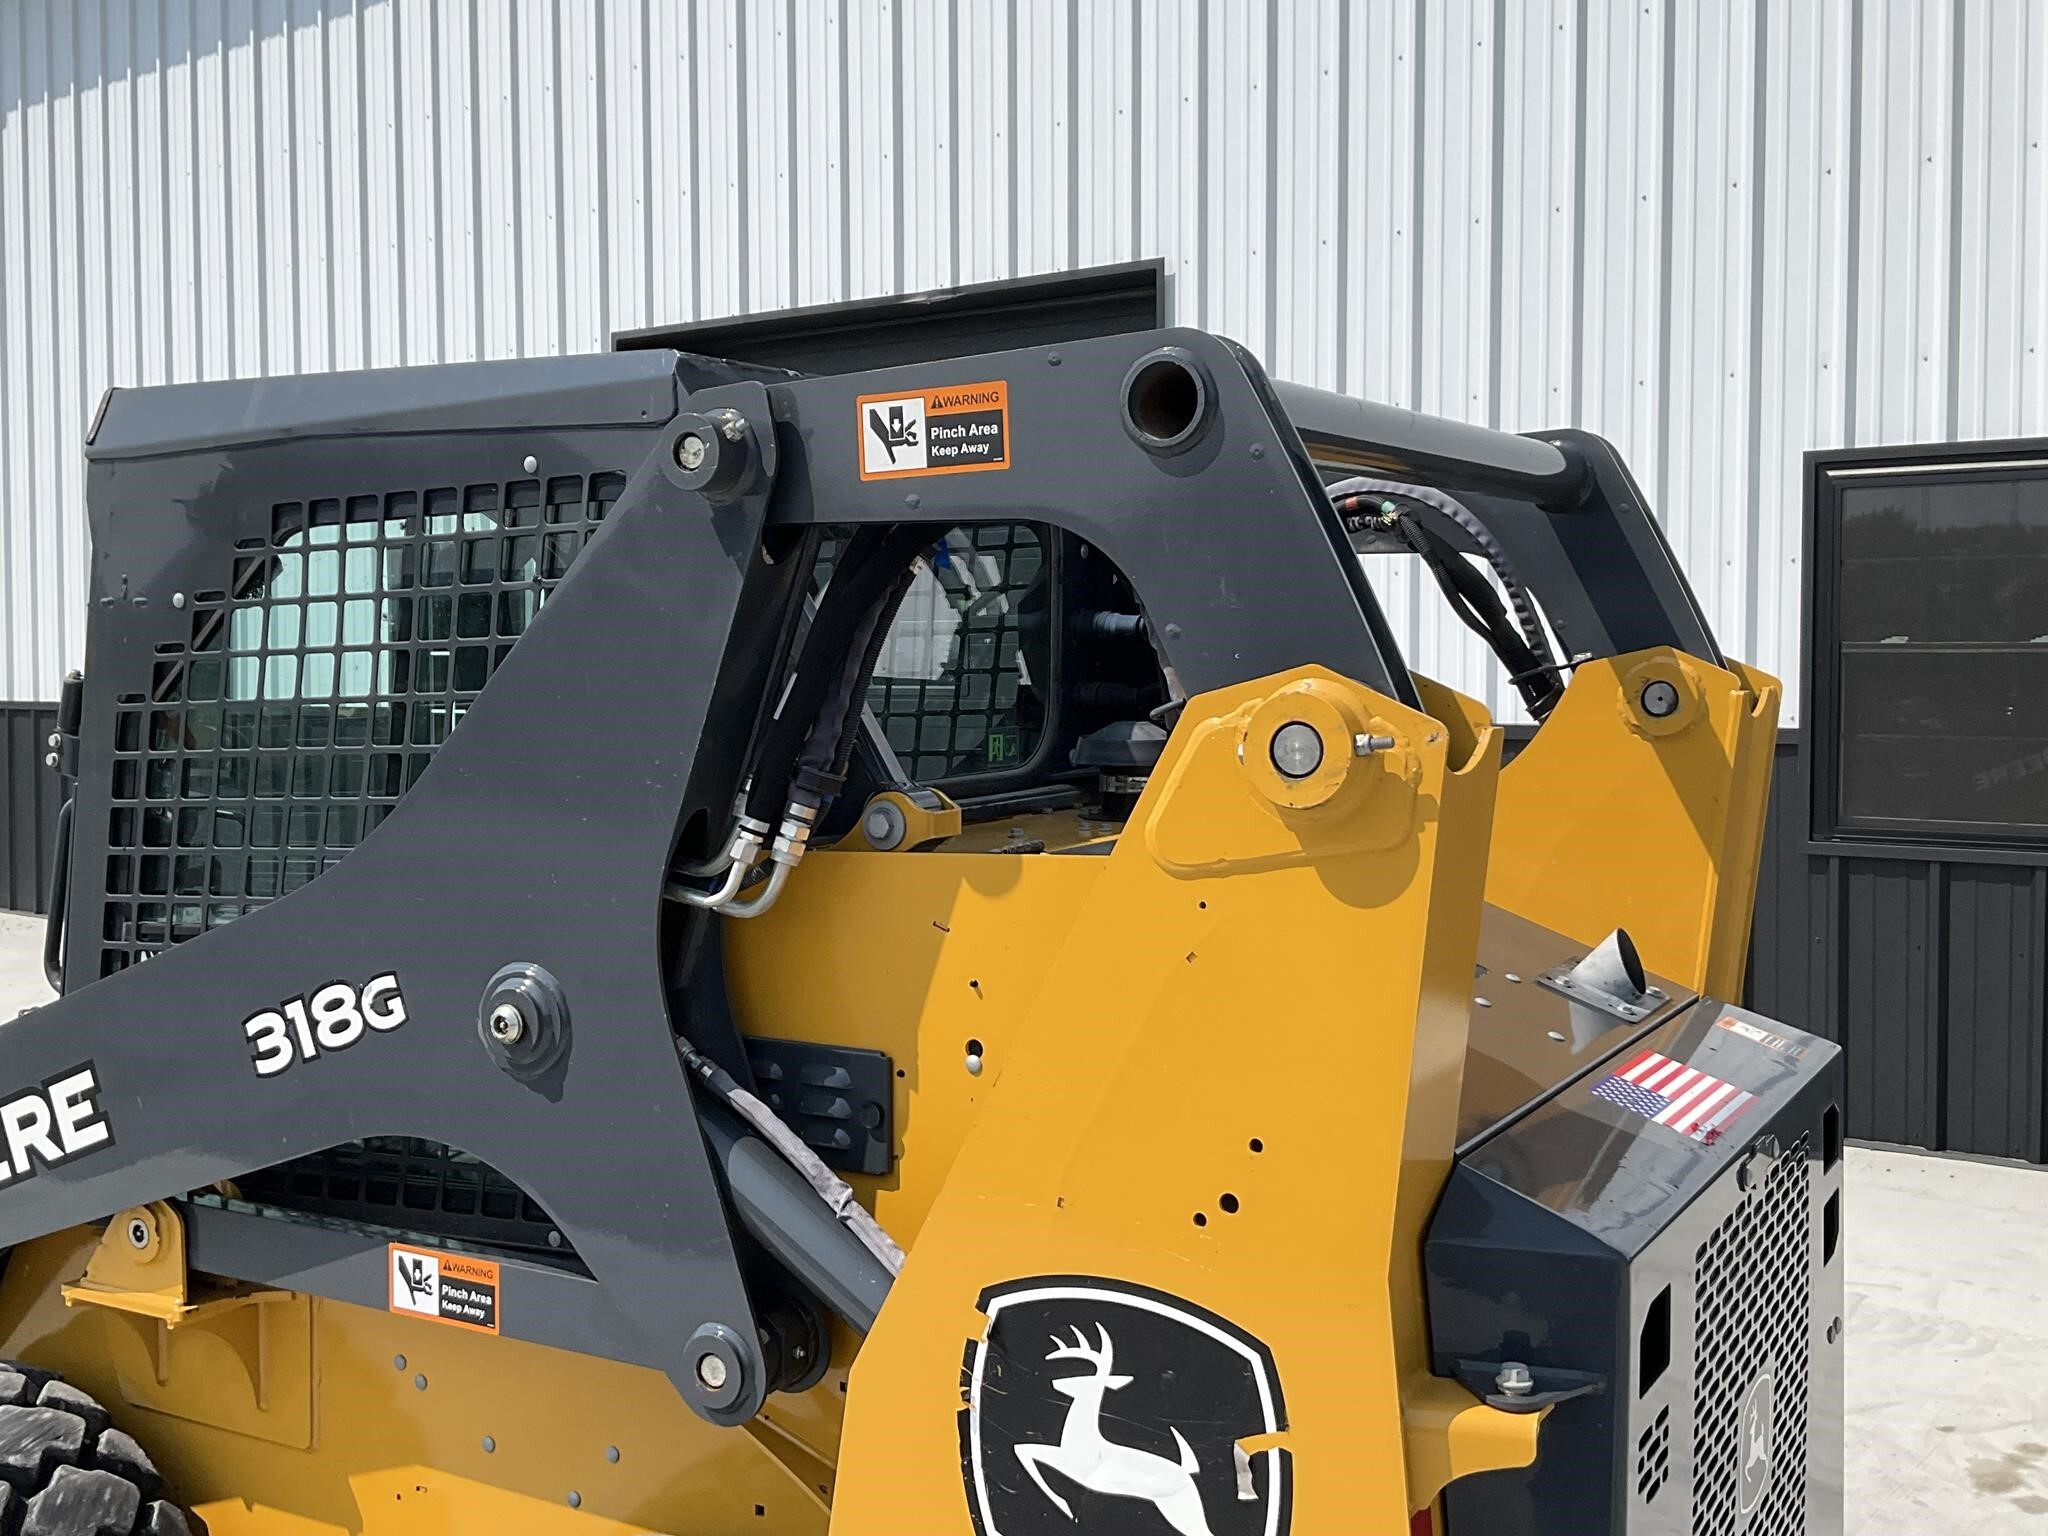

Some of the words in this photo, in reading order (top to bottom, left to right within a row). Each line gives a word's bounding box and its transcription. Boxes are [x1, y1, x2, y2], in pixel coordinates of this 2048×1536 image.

[943, 391, 999, 408] WARNING
[930, 425, 966, 440] Pinch
[969, 423, 998, 437] Area
[931, 445, 958, 457] Keep
[961, 443, 989, 456] Away
[245, 974, 407, 1075] 318G
[0, 1068, 110, 1182] RE
[451, 1263, 493, 1280] WARNING
[441, 1284, 468, 1300] Pinch
[470, 1290, 492, 1305] Area
[441, 1299, 462, 1314] Keep
[464, 1303, 485, 1320] Away
